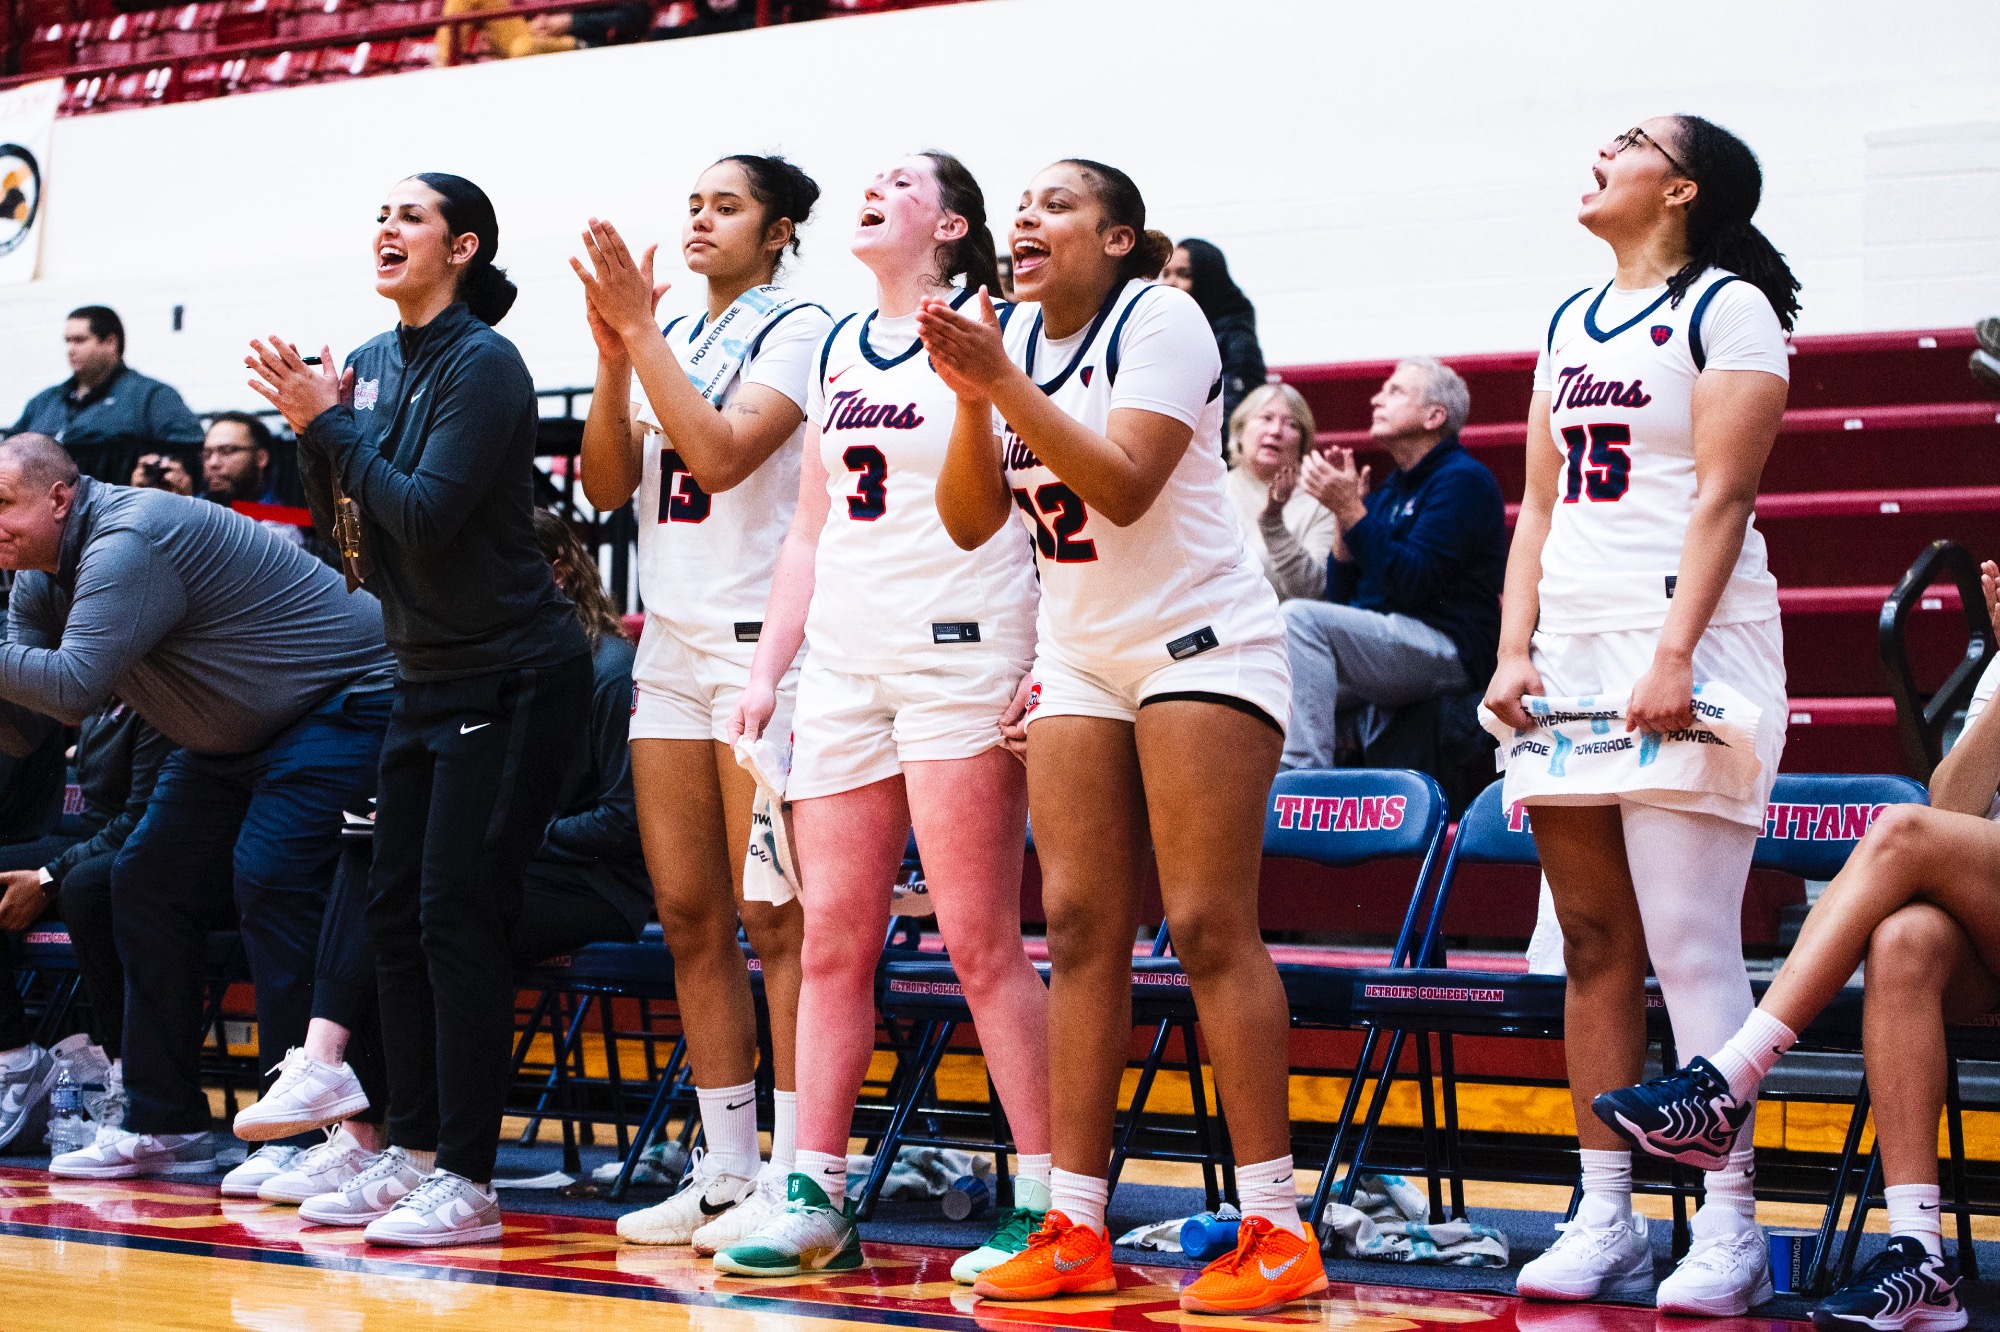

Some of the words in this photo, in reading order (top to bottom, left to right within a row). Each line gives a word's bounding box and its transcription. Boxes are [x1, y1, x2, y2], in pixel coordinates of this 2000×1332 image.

[690, 306, 740, 365] POWERADE
[822, 389, 925, 434] Titans
[1553, 363, 1652, 414] Titans
[842, 445, 887, 521] 3
[1560, 423, 1631, 503] 15
[1012, 481, 1098, 563] 12
[1574, 737, 1634, 756] POWERADE
[1274, 795, 1407, 831] TITANS
[891, 979, 930, 994] DETROITS
[1131, 973, 1172, 986] ETROITS
[1365, 985, 1417, 998] DETROITS
[1419, 987, 1468, 1000] COLLEGE
[1470, 989, 1504, 1001] TEAM
[1791, 1236, 1802, 1289] POWERADE
